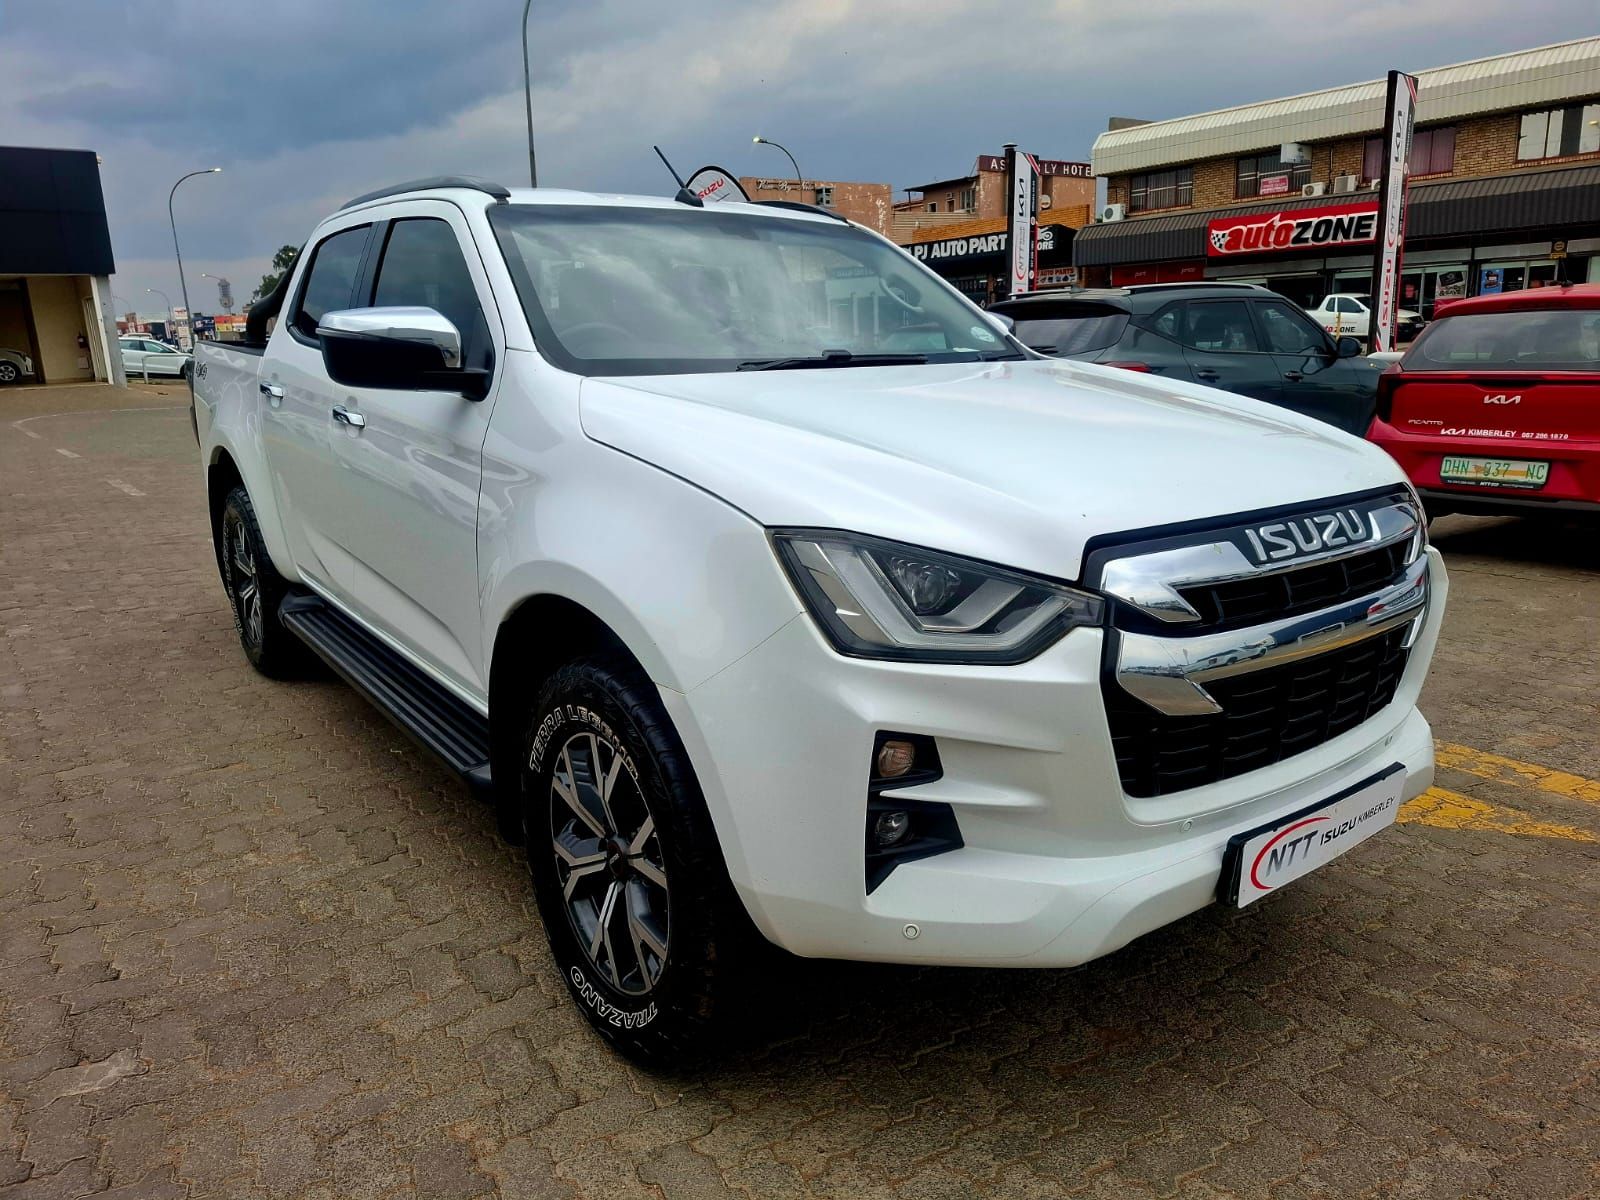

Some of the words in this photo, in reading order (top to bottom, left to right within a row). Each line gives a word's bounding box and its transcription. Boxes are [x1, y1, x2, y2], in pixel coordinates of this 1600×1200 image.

[1063, 165, 1094, 177] HOTE
[697, 178, 724, 200] SUZU
[914, 245, 928, 260] PJ
[931, 238, 968, 258] AUTO
[968, 233, 1008, 254] PART
[1037, 240, 1054, 251] ORE
[1382, 258, 1392, 327] ISUZU
[1484, 394, 1522, 405] KIA
[1440, 428, 1466, 436] KIA
[1467, 429, 1517, 438] KIMBERLEY
[1442, 458, 1470, 475] DHN
[1525, 463, 1545, 482] NC
[1244, 508, 1368, 562] ISUZU
[529, 706, 567, 774] TERRA
[1265, 829, 1319, 878] NTT
[1319, 815, 1358, 846] ISUZU
[1357, 795, 1396, 824] KIMBERLEY
[570, 965, 658, 1029] TRAZANO
